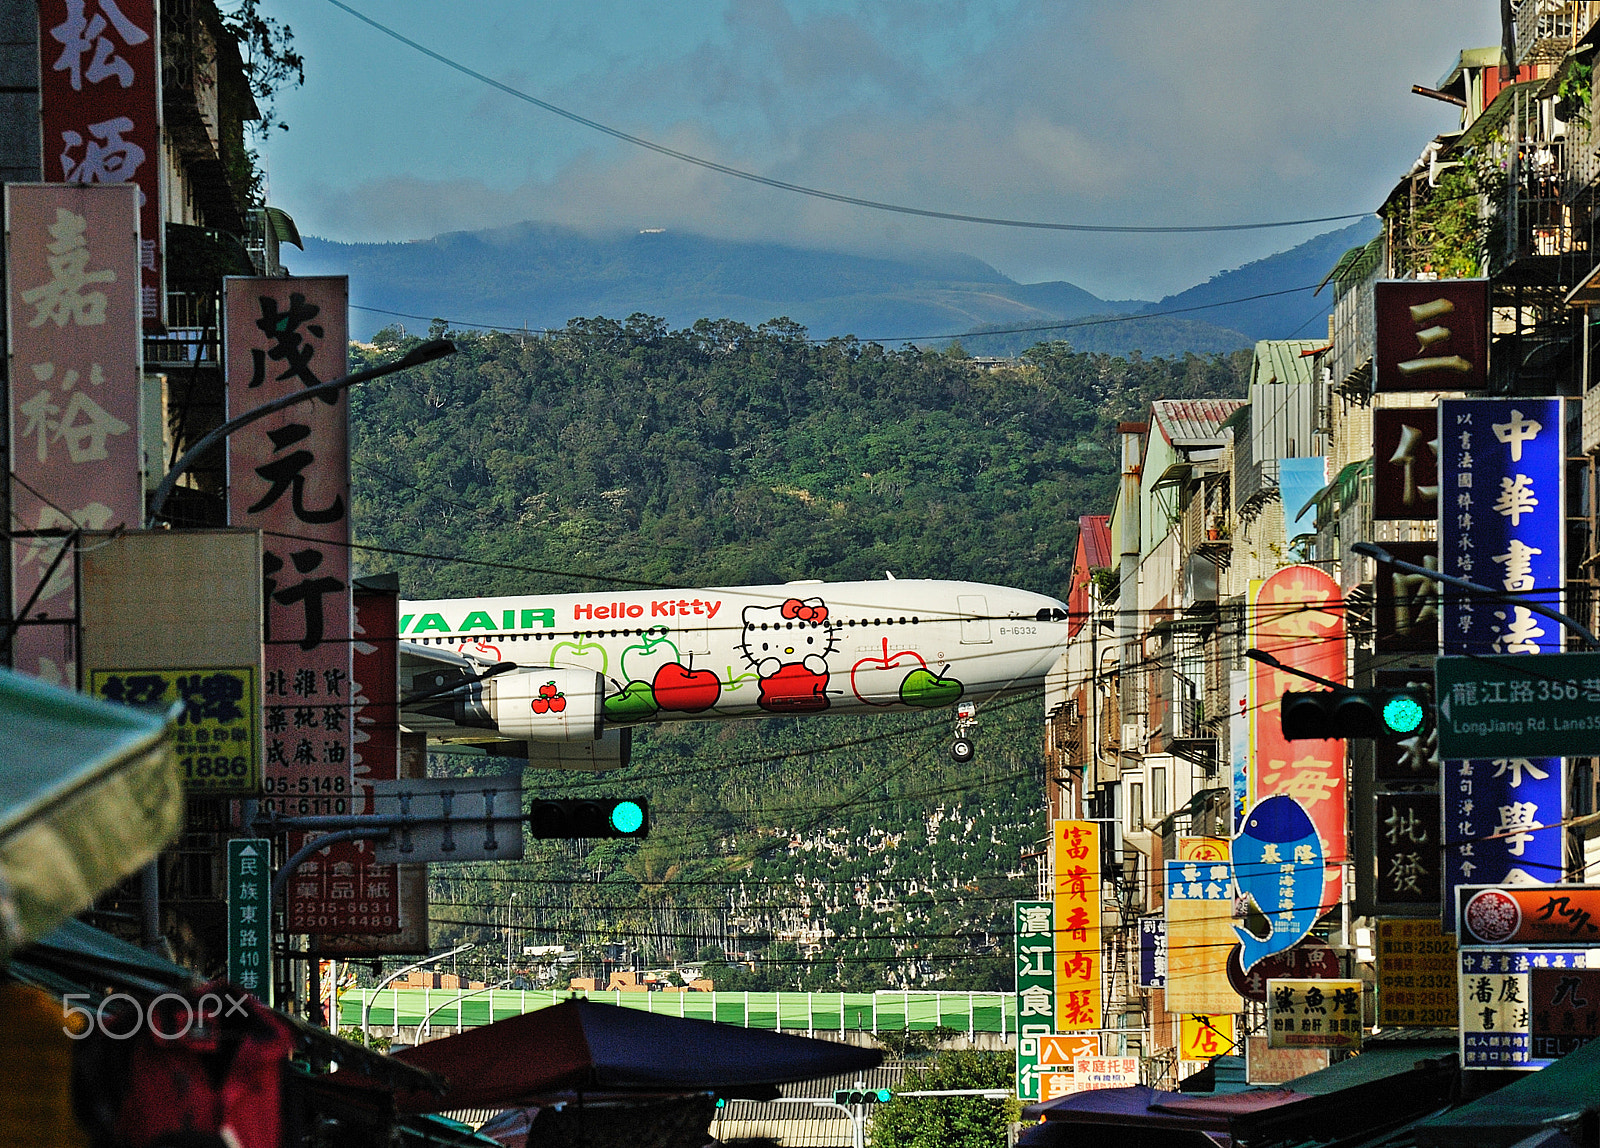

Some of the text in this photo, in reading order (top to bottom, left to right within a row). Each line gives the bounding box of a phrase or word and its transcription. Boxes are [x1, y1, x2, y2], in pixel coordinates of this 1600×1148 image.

[458, 607, 556, 632] AIR
[573, 598, 722, 621] Hello Kitty
[999, 626, 1037, 636] B-16332
[1453, 719, 1523, 736] LongJiang
[1527, 717, 1550, 732] Rd.
[1260, 843, 1318, 864] 基隆
[1385, 807, 1427, 893] 批發
[1060, 826, 1095, 1026] 富貴香肉鬆
[1019, 906, 1053, 1096] 濱江食品行
[1275, 986, 1359, 1016] 鯊魚煙
[1469, 975, 1524, 1004] 潘慶
[1193, 1021, 1218, 1053] 店
[1077, 1060, 1136, 1073] 家庭托嬰
